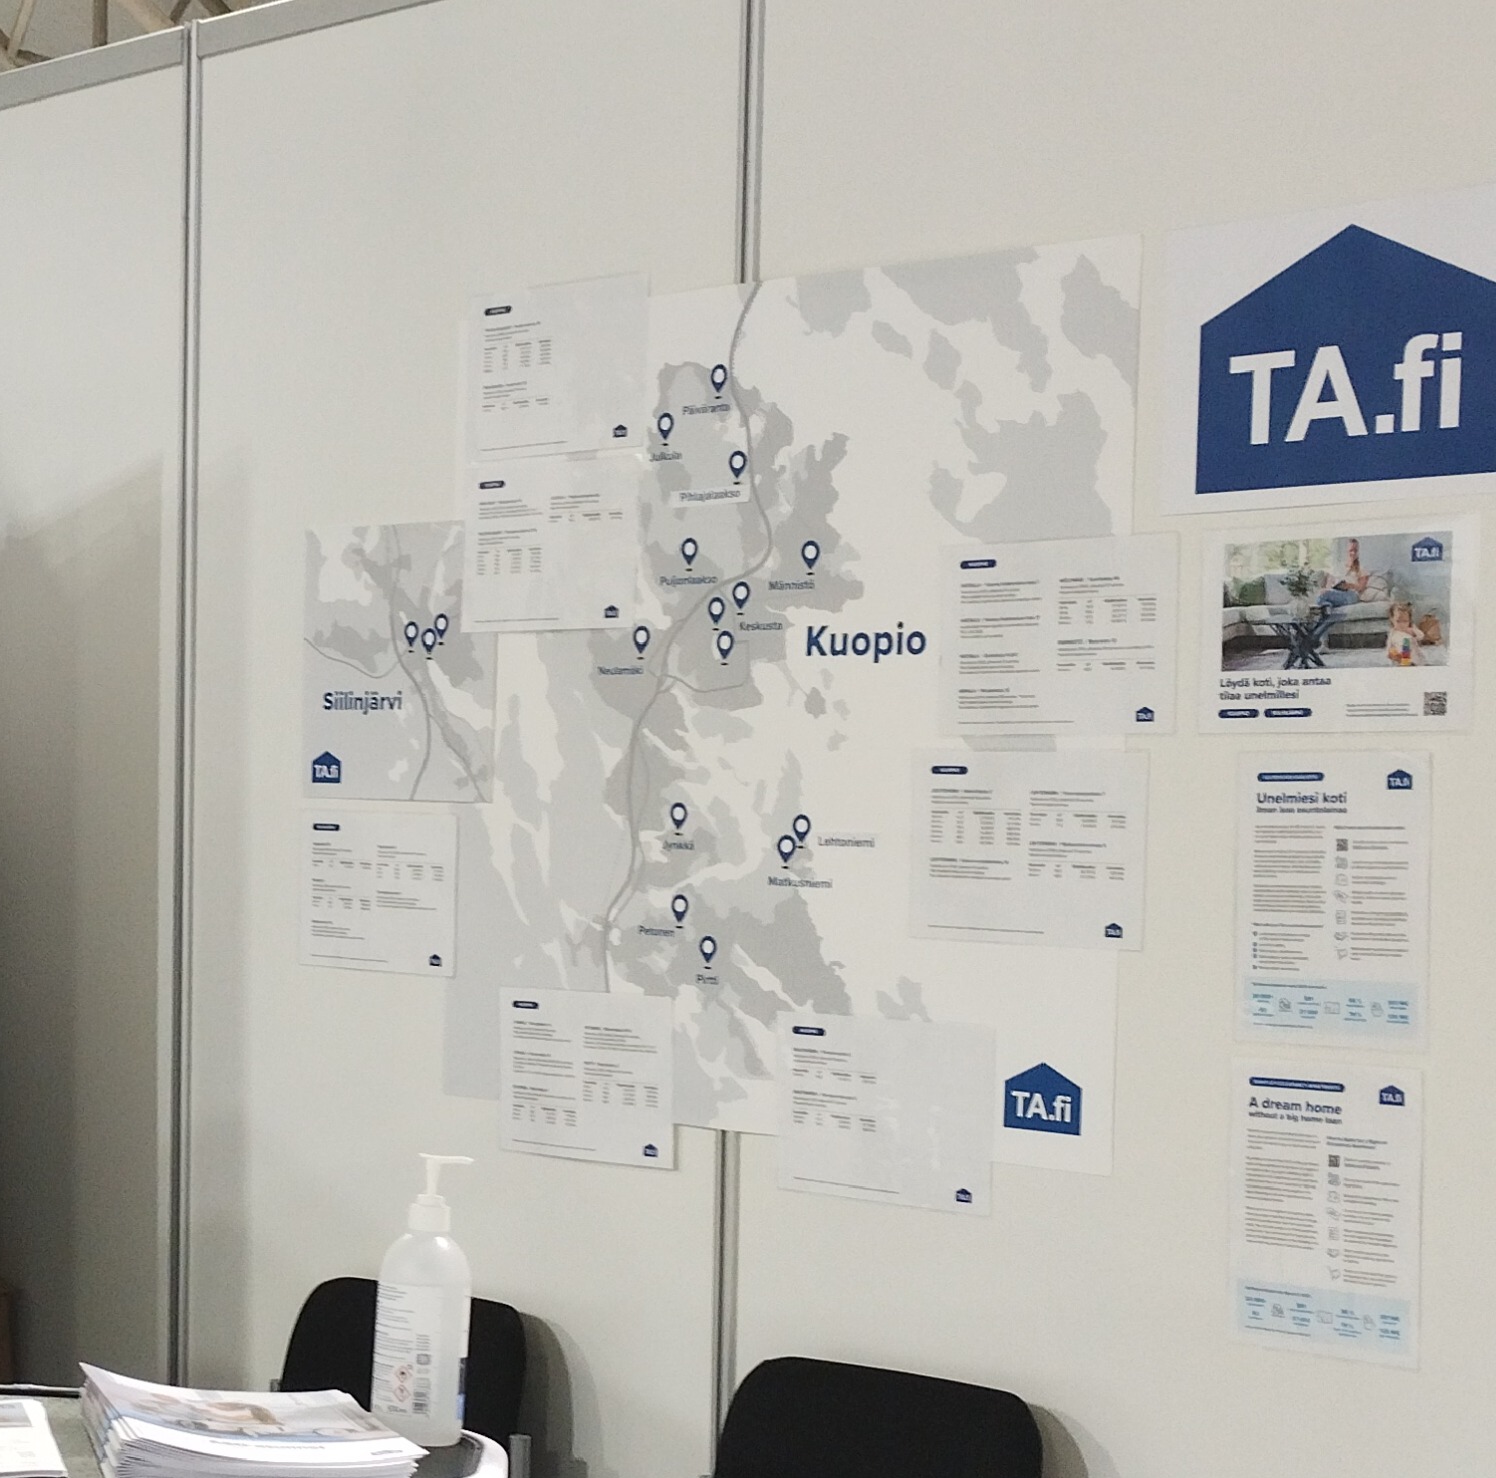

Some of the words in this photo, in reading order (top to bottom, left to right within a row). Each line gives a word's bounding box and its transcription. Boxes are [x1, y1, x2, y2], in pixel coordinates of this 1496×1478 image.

[1229, 332, 1464, 445] TA.fi
[806, 621, 927, 663] Kuopio
[1219, 677, 1250, 689] Löydä
[1277, 677, 1299, 688] joka
[1302, 677, 1332, 686] antaa
[323, 691, 402, 715] Siilinjärvi
[1257, 791, 1319, 804] Unelmiesi
[1322, 791, 1347, 803] koti
[818, 836, 875, 848] Lehtoniemi
[1011, 1090, 1071, 1123] TA.fi
[1249, 1097, 1259, 1108] A
[1262, 1098, 1302, 1112] dream
[1305, 1101, 1342, 1115] home
